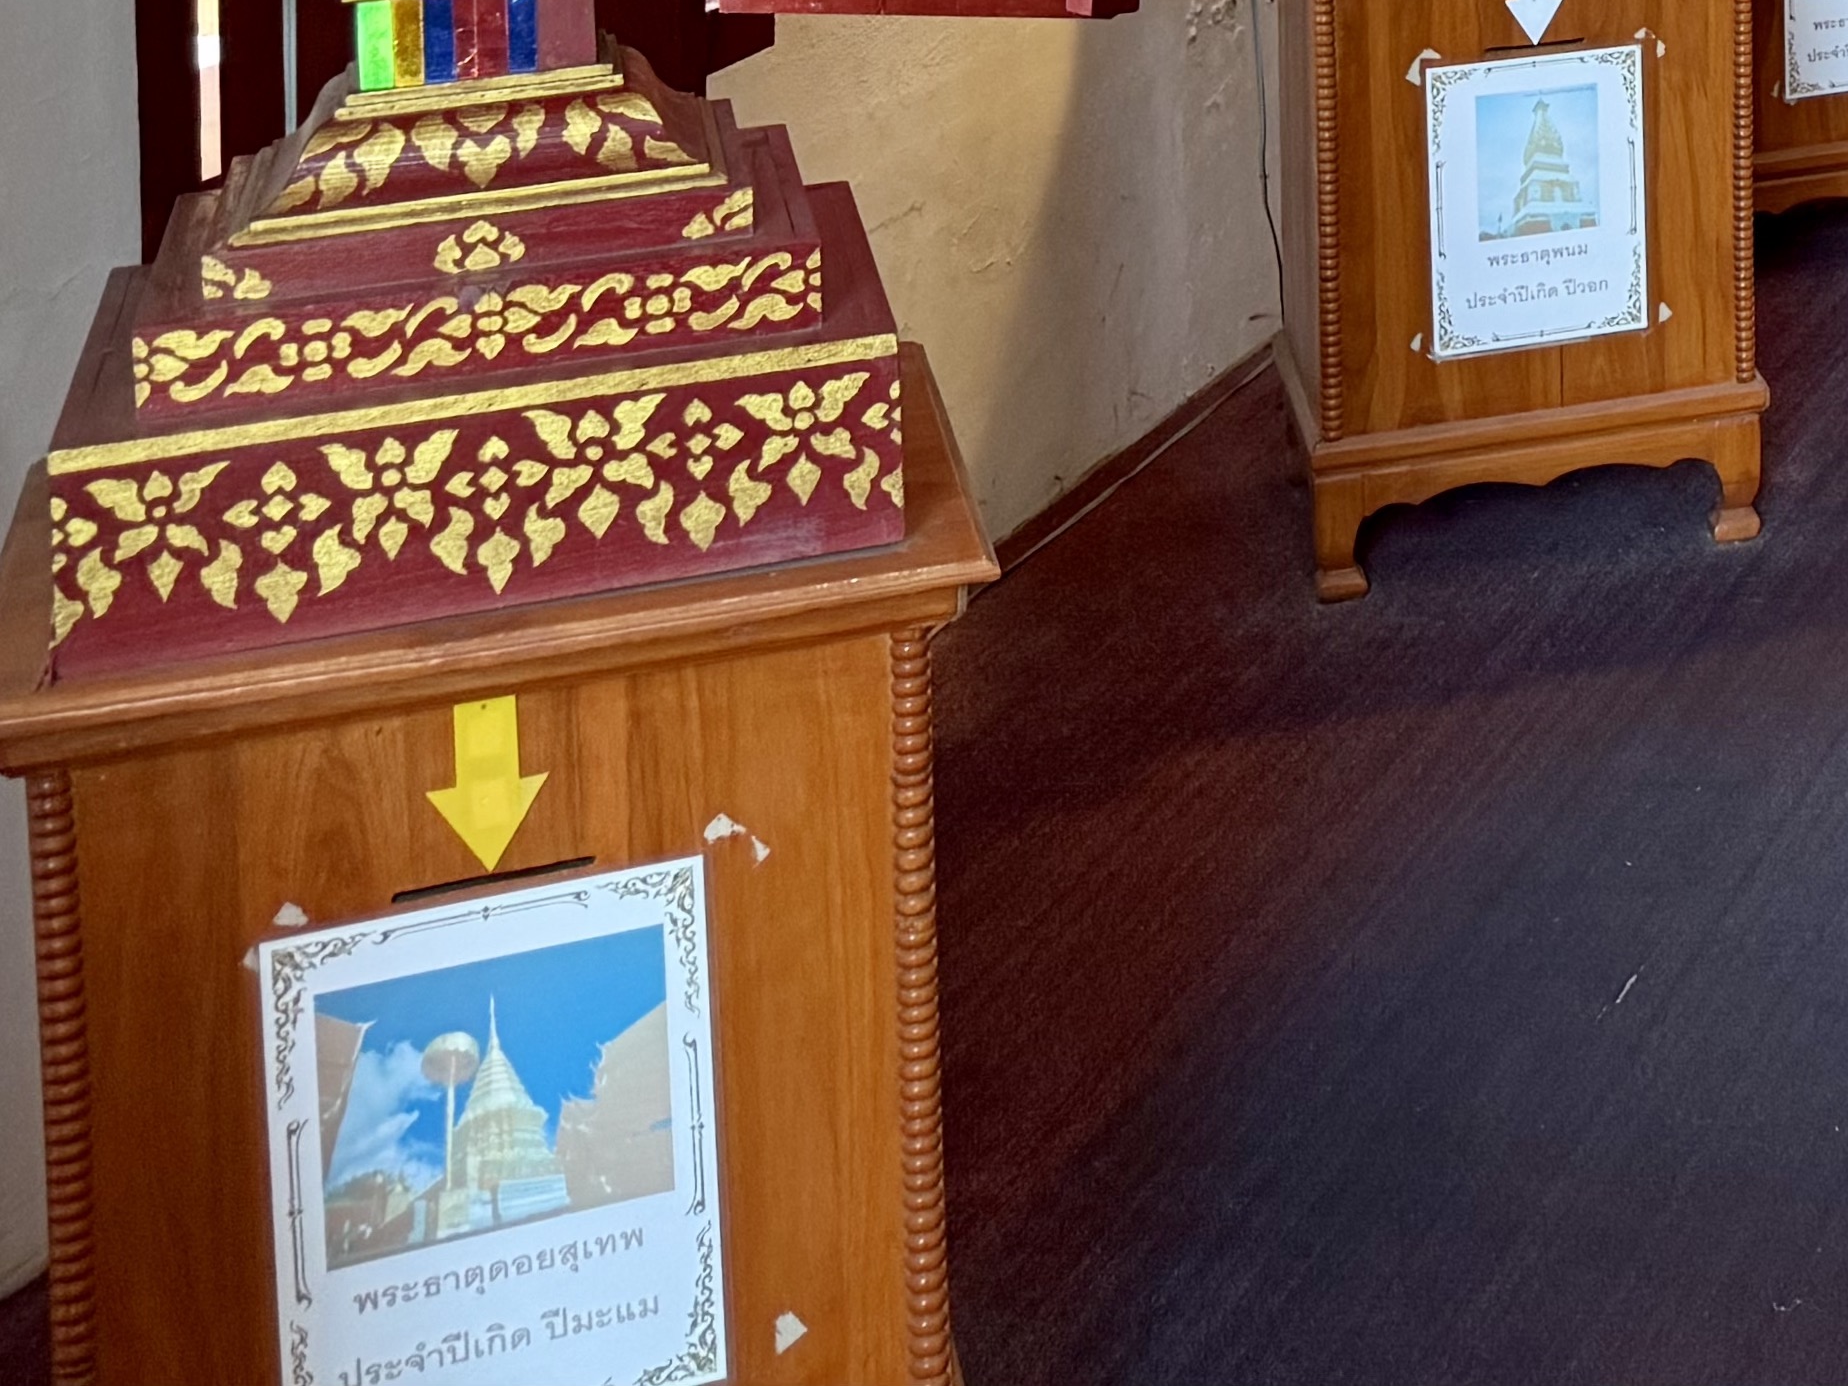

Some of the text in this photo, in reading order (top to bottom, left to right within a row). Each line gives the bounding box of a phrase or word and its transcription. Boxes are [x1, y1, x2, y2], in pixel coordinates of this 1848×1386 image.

[1487, 243, 1588, 268] พระธาตุพนม
[1465, 278, 1609, 310] ประจำปีเกิด ปีวอก
[353, 1226, 644, 1315] พระธาตุดอยสุเทพ
[338, 1293, 660, 1386] ประจำปีเกิด ปีมะแม
